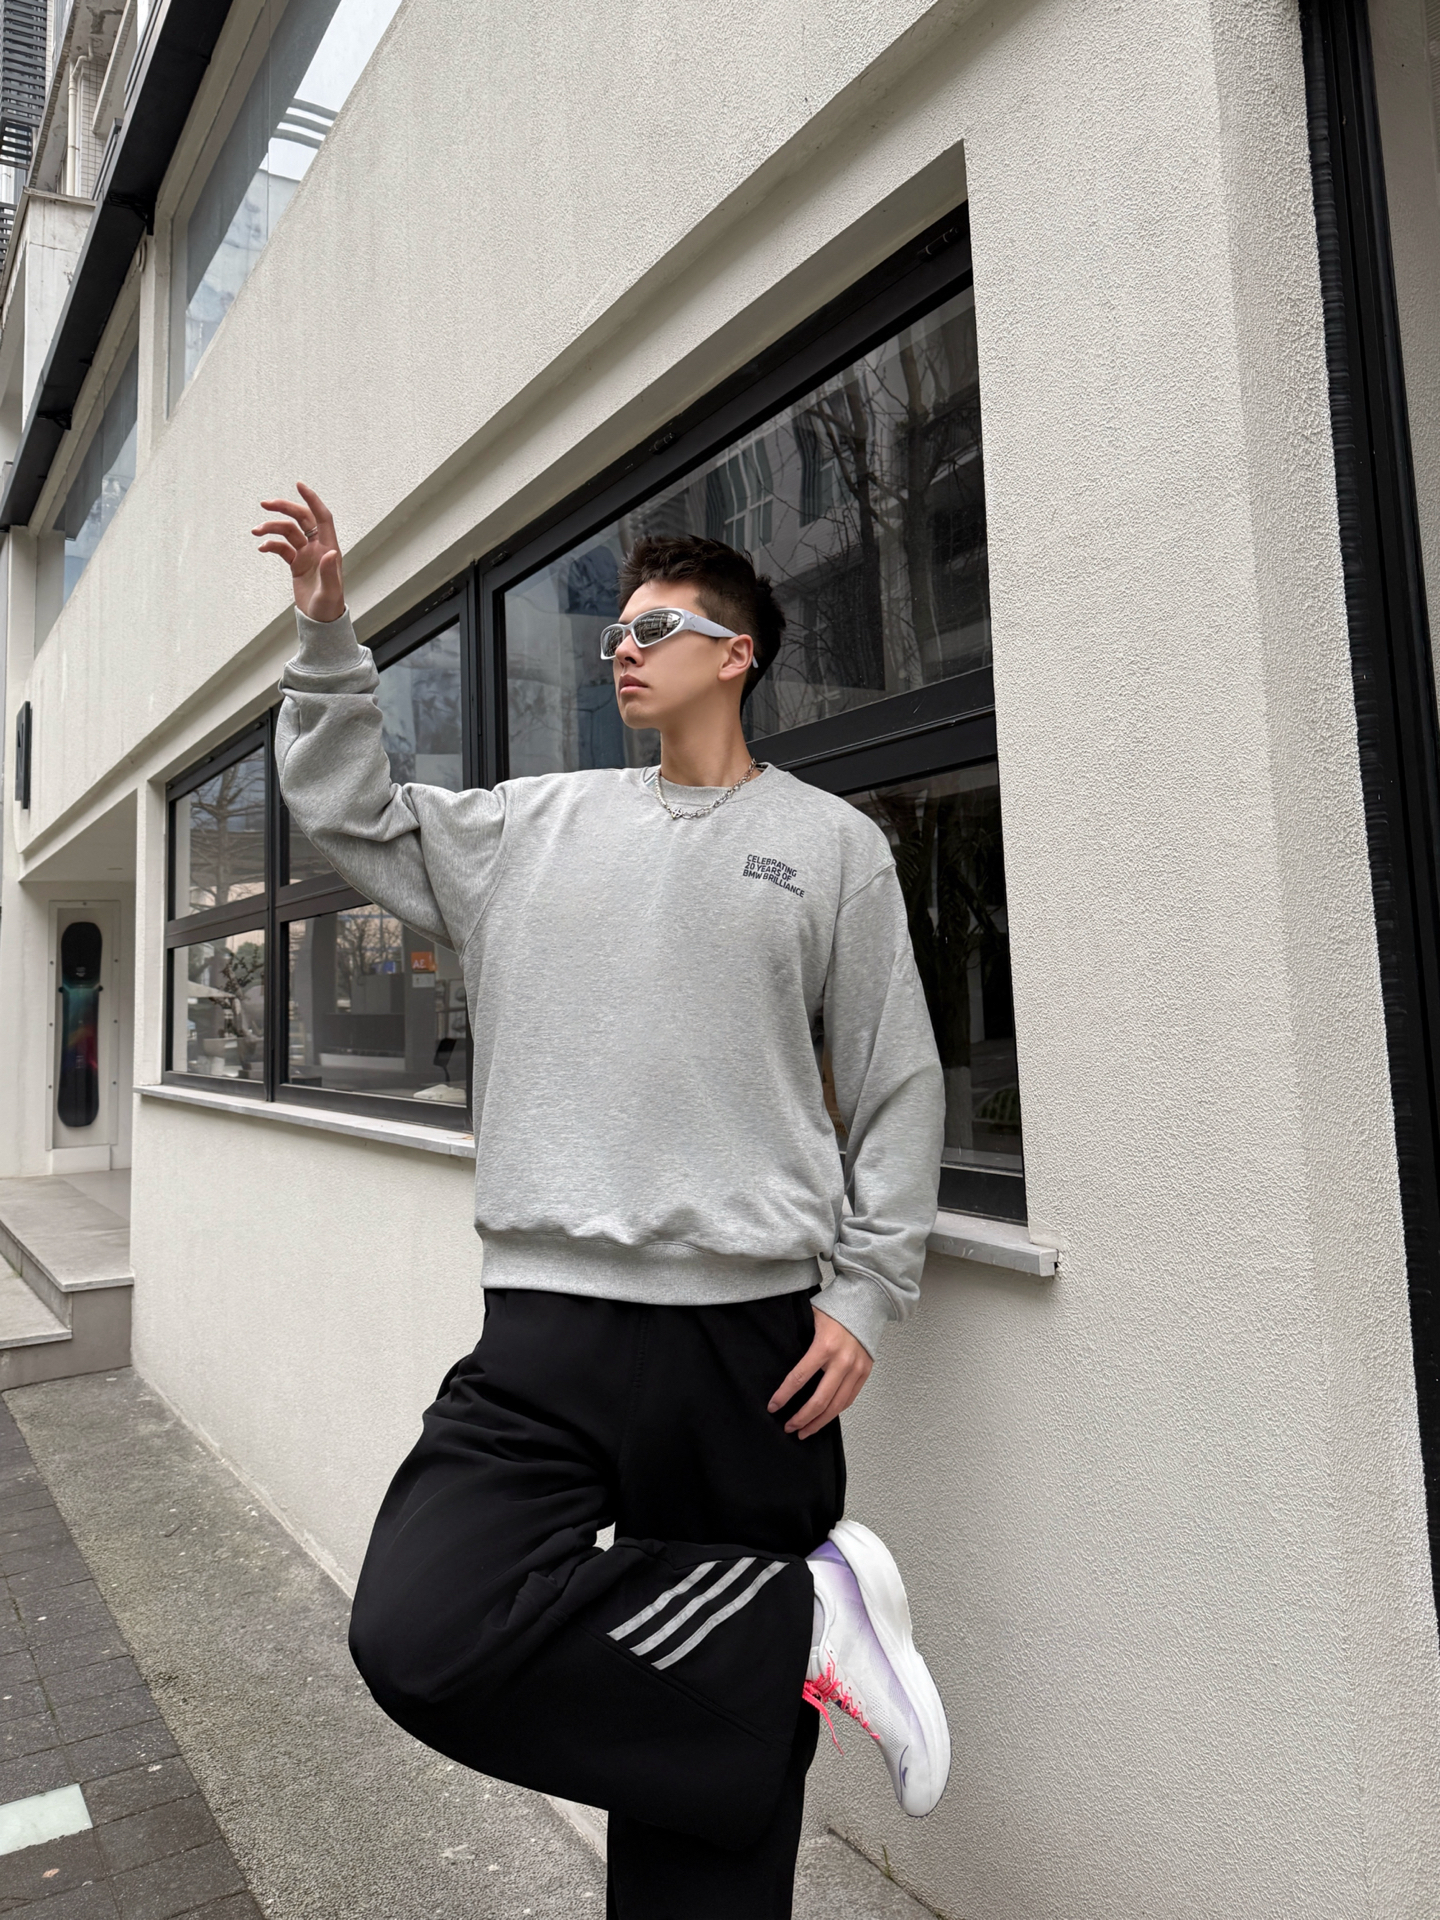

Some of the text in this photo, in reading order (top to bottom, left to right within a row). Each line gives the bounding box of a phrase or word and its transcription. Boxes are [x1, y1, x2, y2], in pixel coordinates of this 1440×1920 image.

[745, 861, 792, 882] 20 YEARS OF
[747, 854, 797, 877] CELEBRATING
[743, 869, 805, 898] BMW BRILLIANCE
